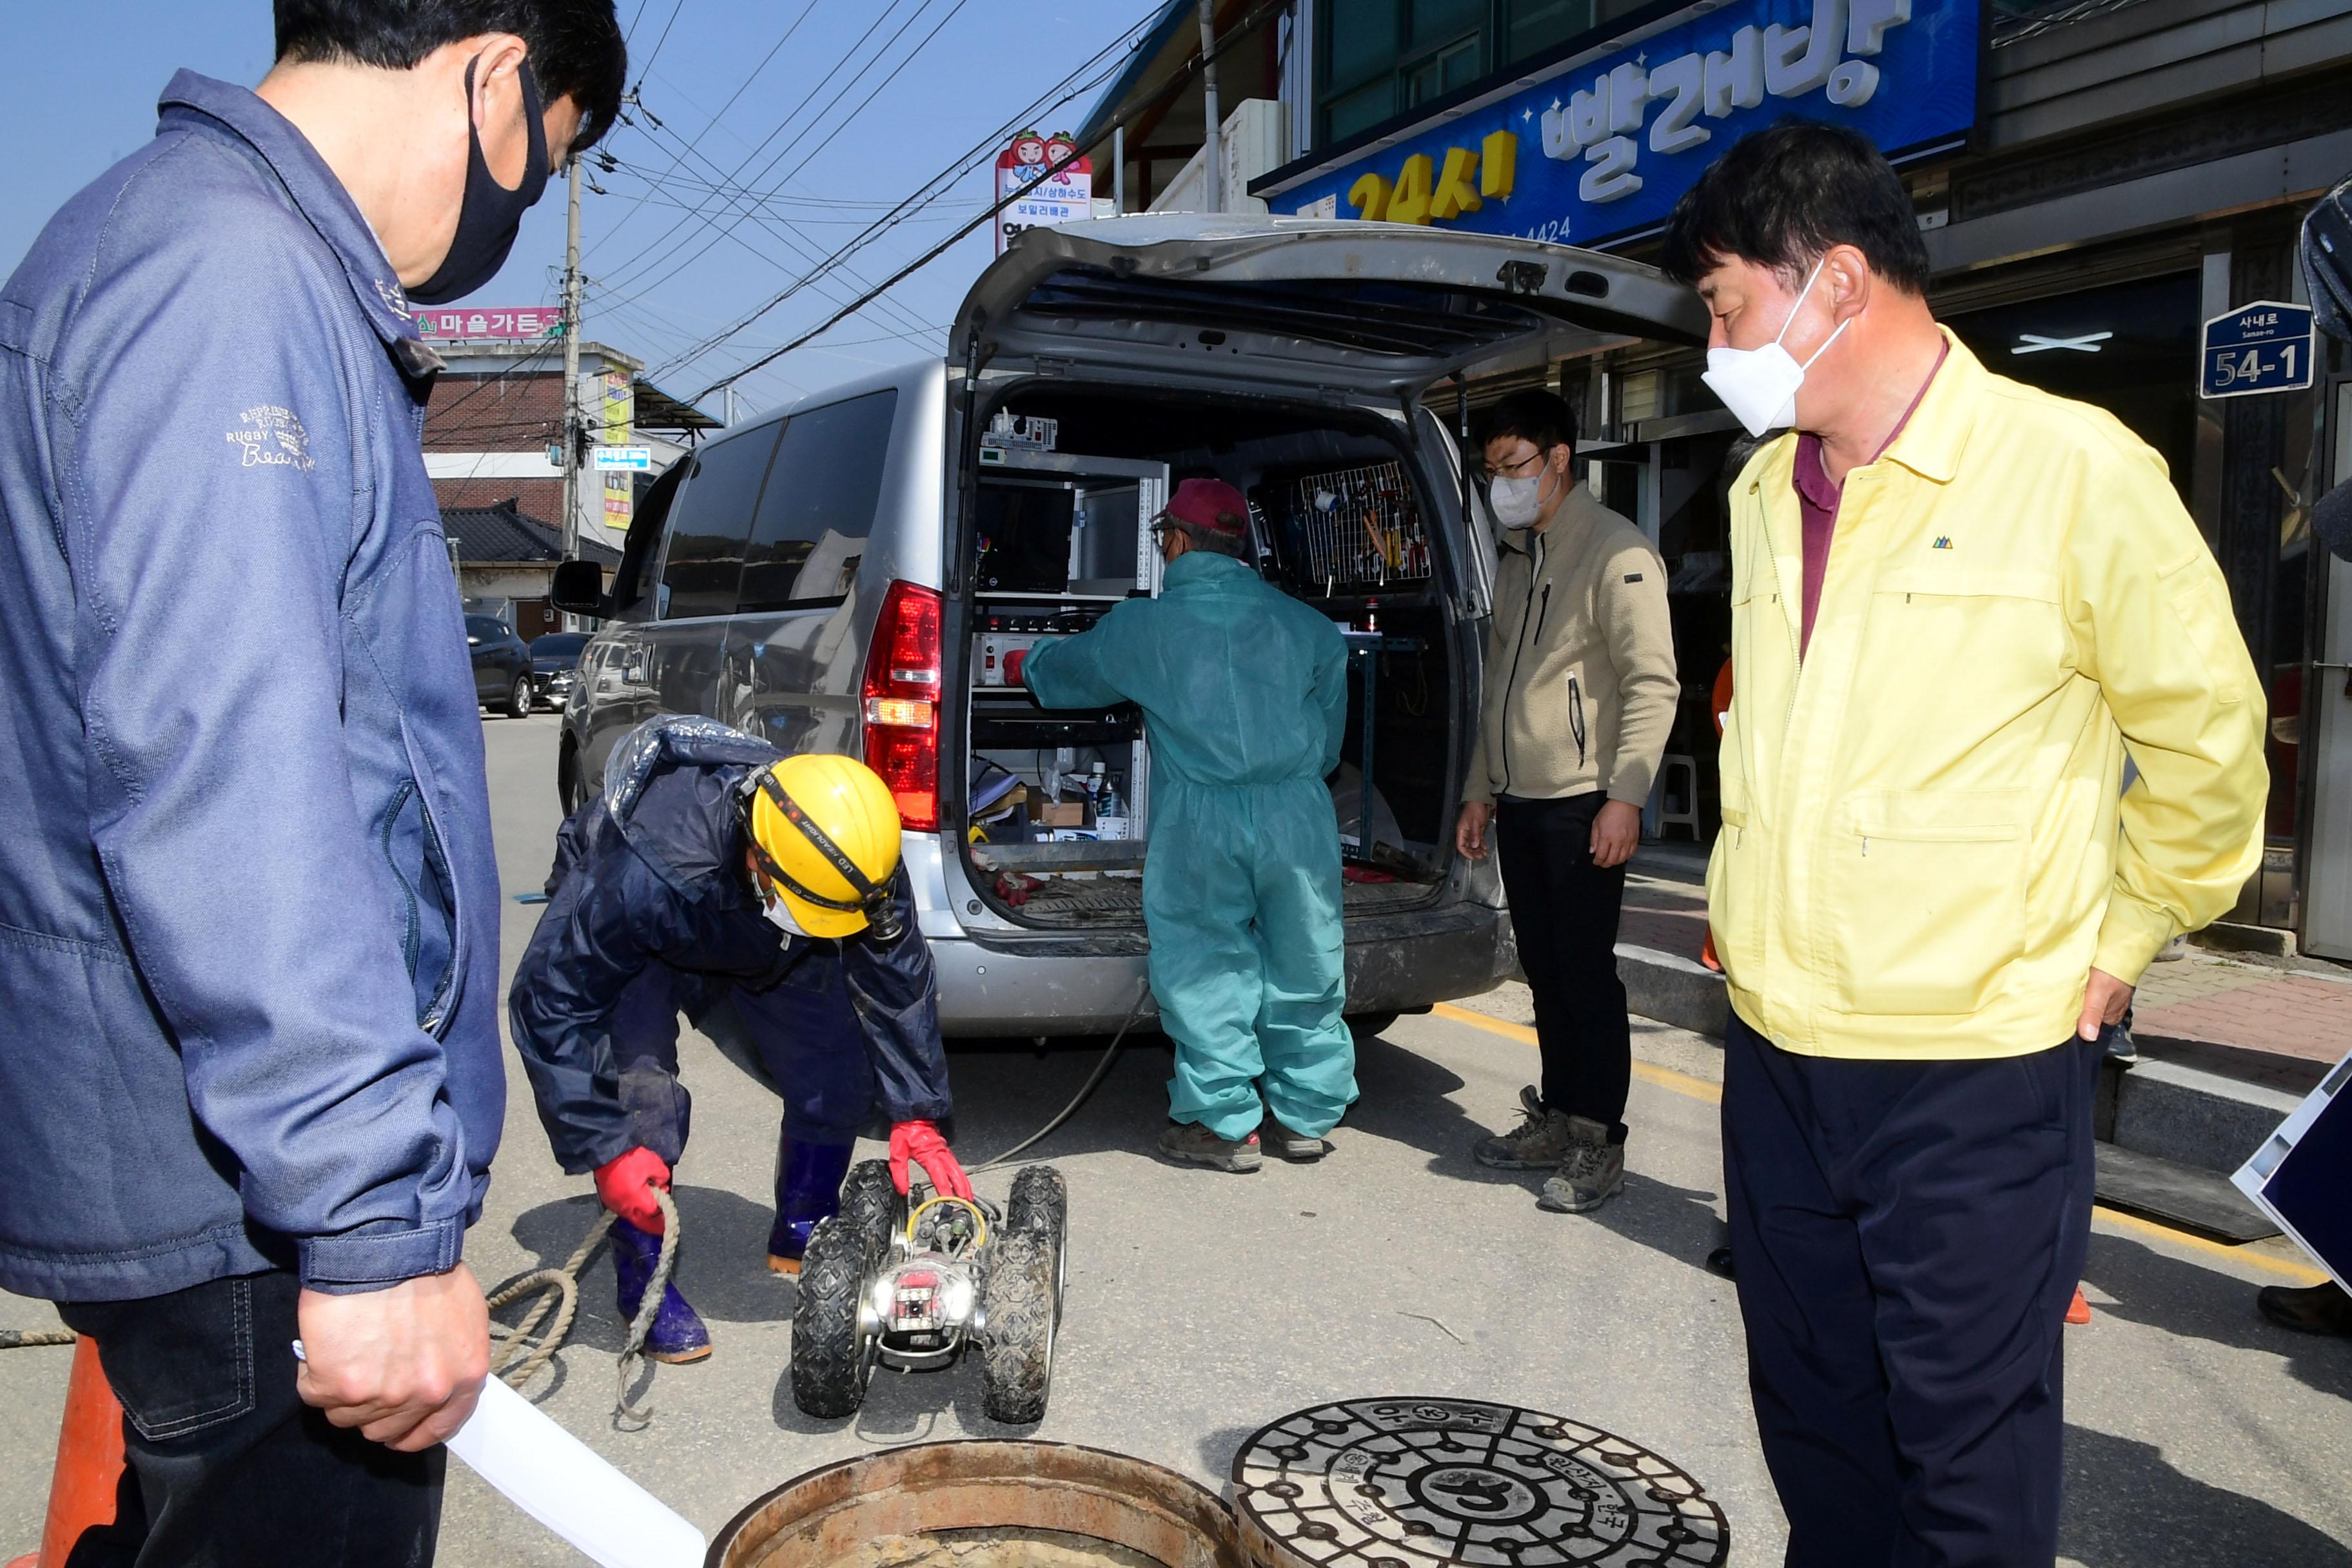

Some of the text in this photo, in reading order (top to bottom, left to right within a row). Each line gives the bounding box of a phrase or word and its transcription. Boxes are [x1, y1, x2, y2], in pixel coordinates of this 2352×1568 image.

[1348, 0, 1911, 225] 24시 빨래방
[1017, 204, 1069, 218] 보일러배관
[2239, 313, 2278, 328] 사내로
[2242, 329, 2275, 338] Sanae-ro
[2215, 345, 2296, 386] 54-1
[226, 431, 268, 442] RUGBY
[801, 819, 854, 873] LED HEADLIGHT
